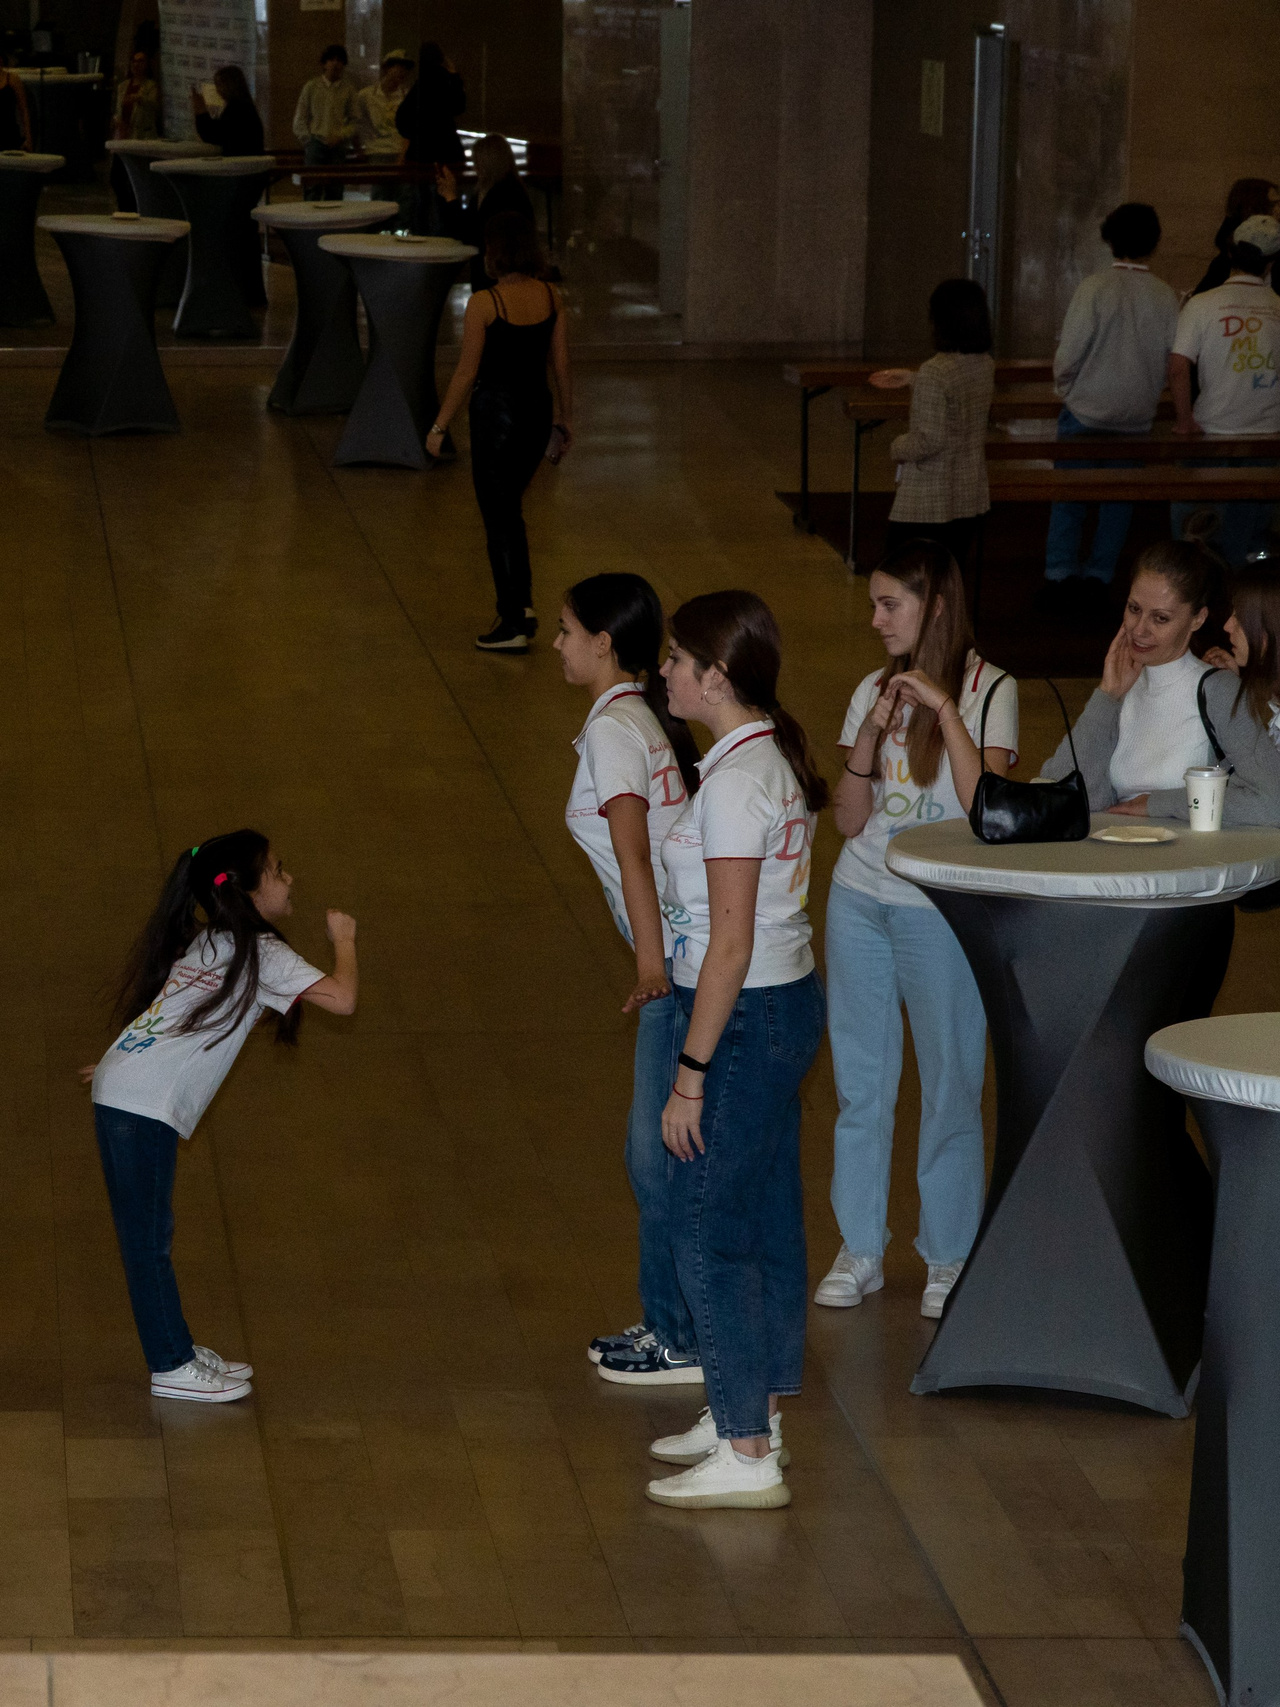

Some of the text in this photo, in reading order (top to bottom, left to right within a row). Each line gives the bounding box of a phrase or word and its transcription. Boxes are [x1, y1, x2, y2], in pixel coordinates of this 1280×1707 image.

[1219, 315, 1263, 337] DO
[1231, 336, 1258, 353] MI
[1232, 350, 1276, 373] SOL
[116, 1032, 157, 1054] KA
